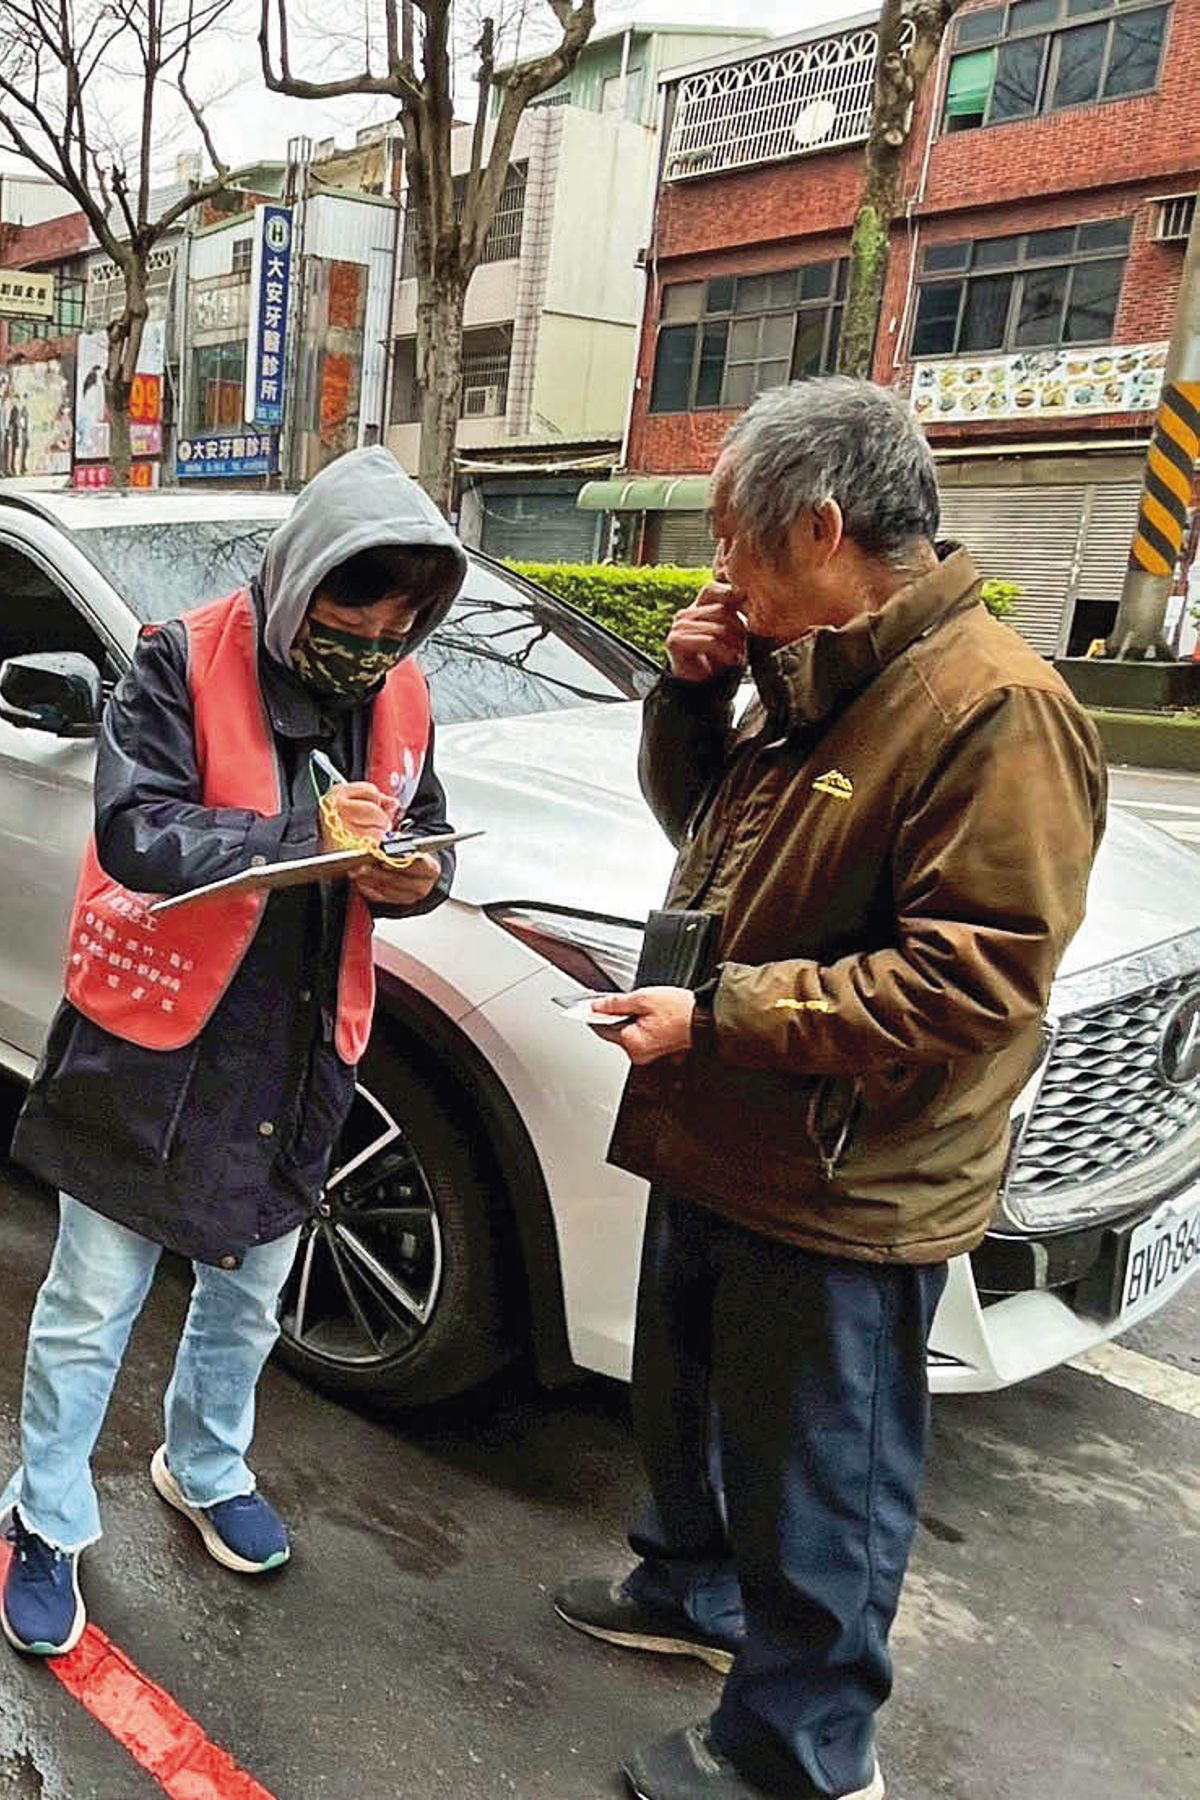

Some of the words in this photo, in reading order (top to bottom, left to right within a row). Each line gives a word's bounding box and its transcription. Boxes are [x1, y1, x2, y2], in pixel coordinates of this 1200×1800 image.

[259, 256, 285, 401] 大安牙醫診所
